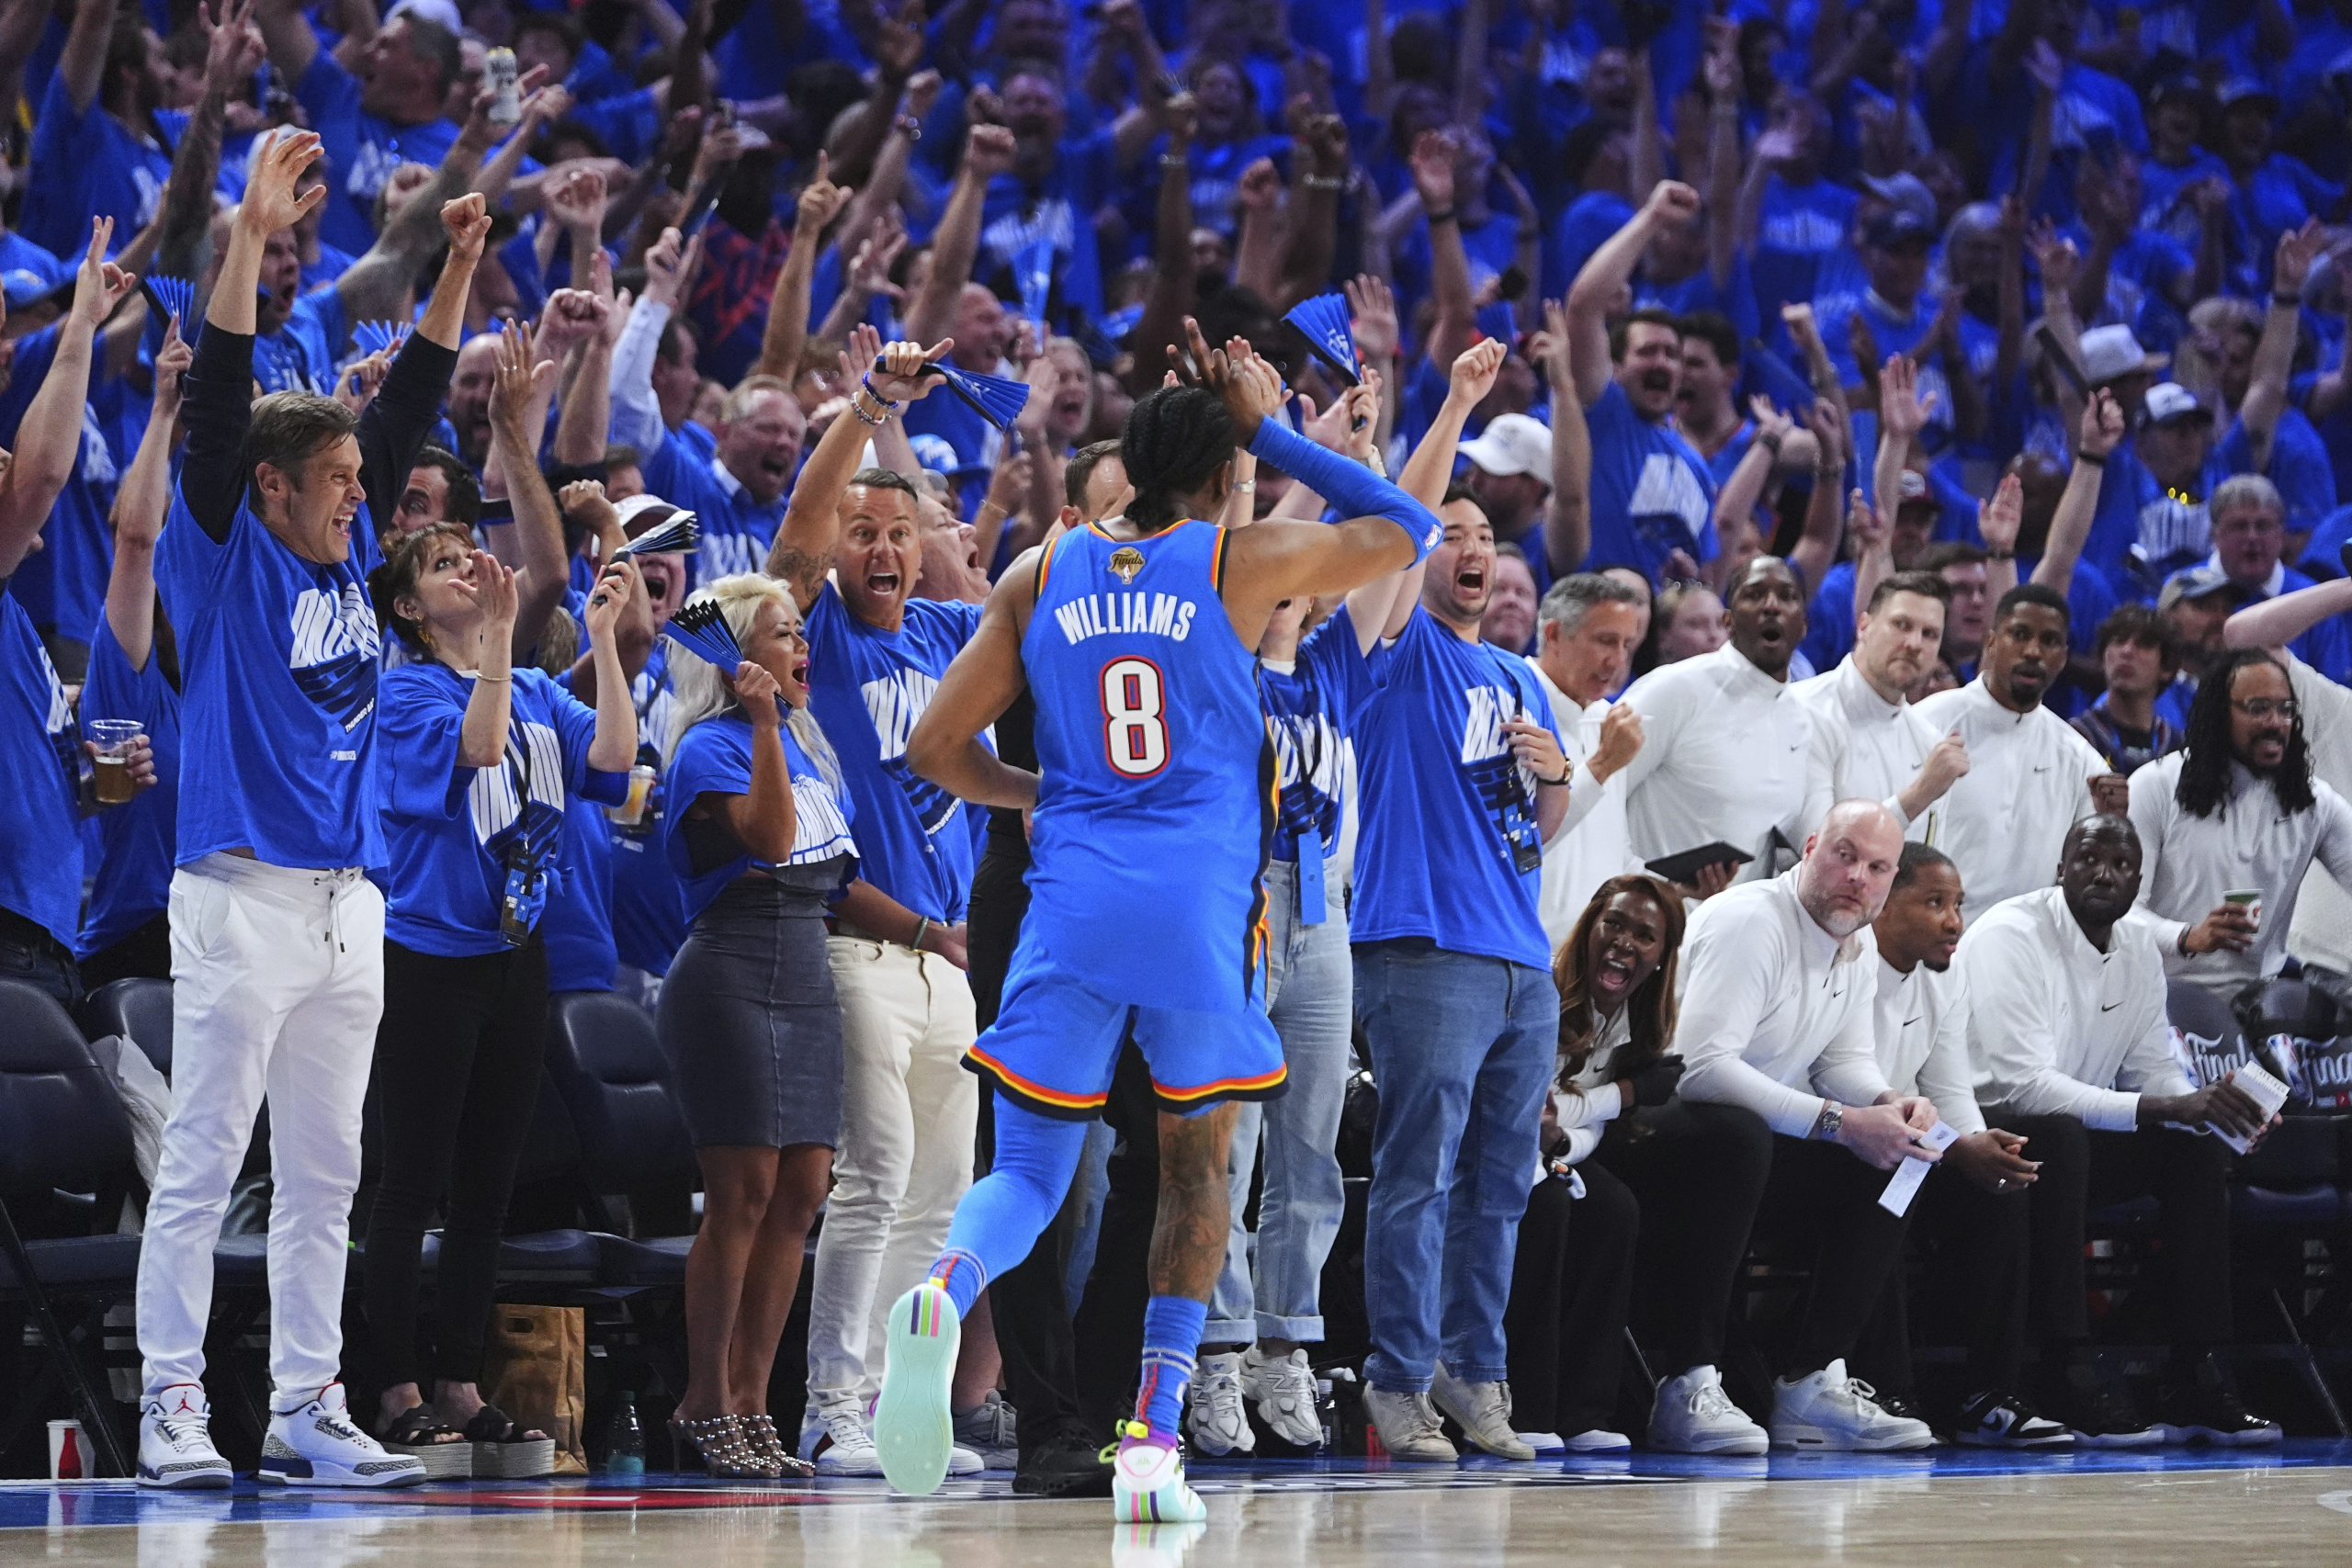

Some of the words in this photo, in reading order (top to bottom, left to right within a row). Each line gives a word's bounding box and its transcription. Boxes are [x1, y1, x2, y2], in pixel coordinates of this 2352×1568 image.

[1110, 553, 1144, 570] Finals
[1055, 592, 1197, 646] WILLIAMS
[1099, 655, 1171, 779] 8
[2185, 1032, 2260, 1088] Final
[2294, 1035, 2352, 1107] Fina
